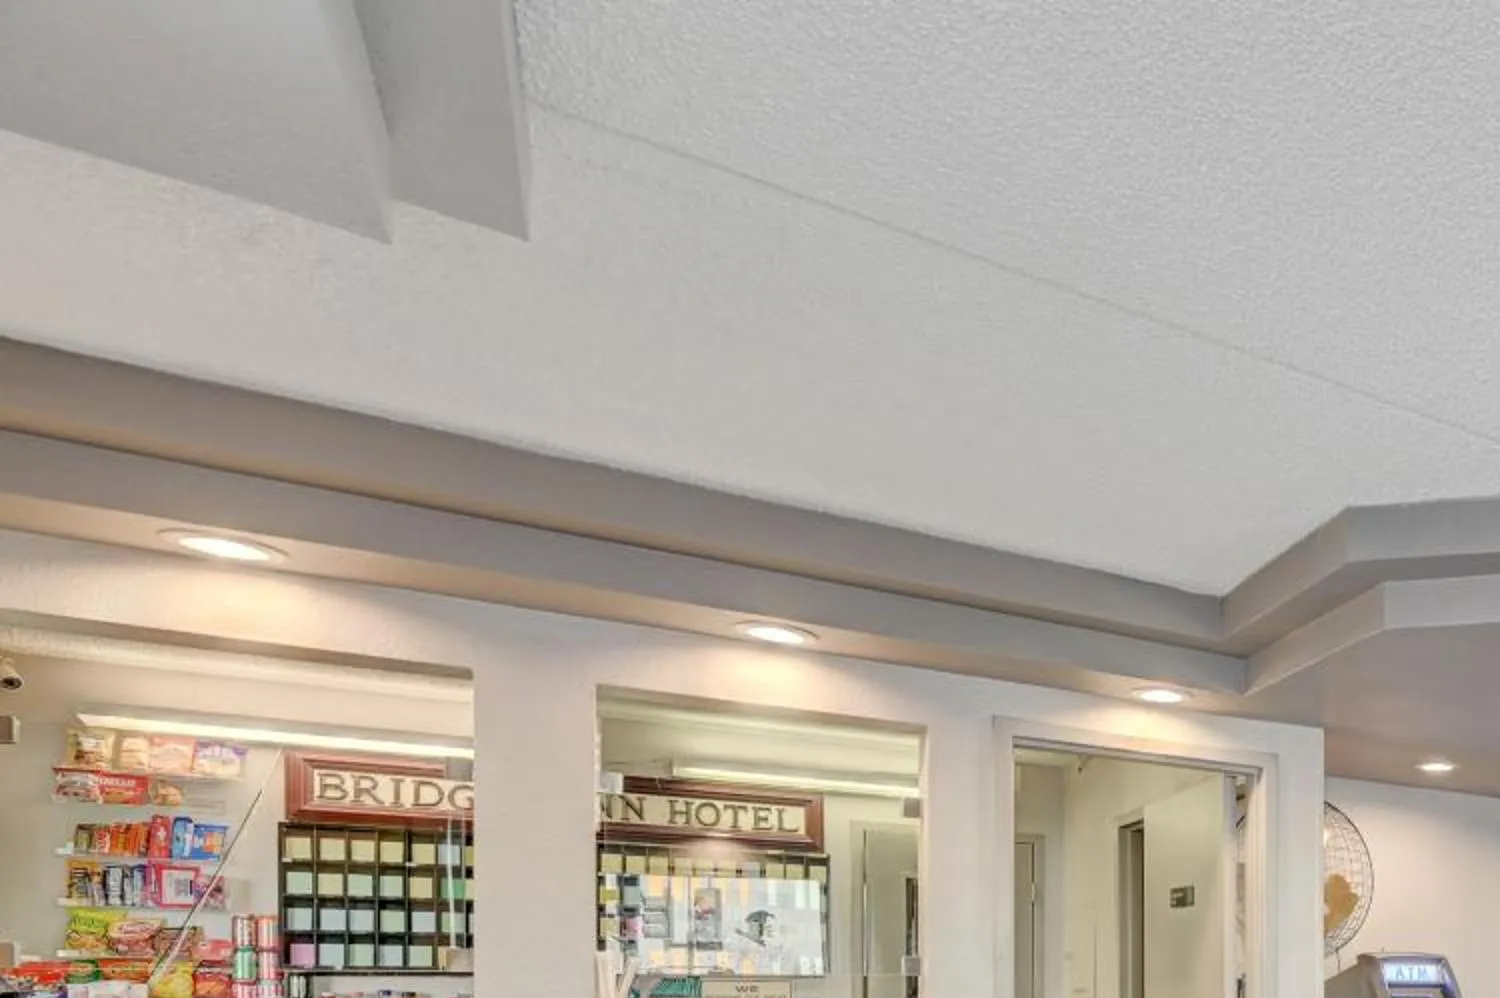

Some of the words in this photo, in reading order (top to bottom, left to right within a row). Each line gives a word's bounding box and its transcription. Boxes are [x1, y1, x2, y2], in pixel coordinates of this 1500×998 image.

[317, 772, 474, 811] BRIDG
[668, 799, 799, 832] HOTEL
[1395, 967, 1429, 980] ATM
